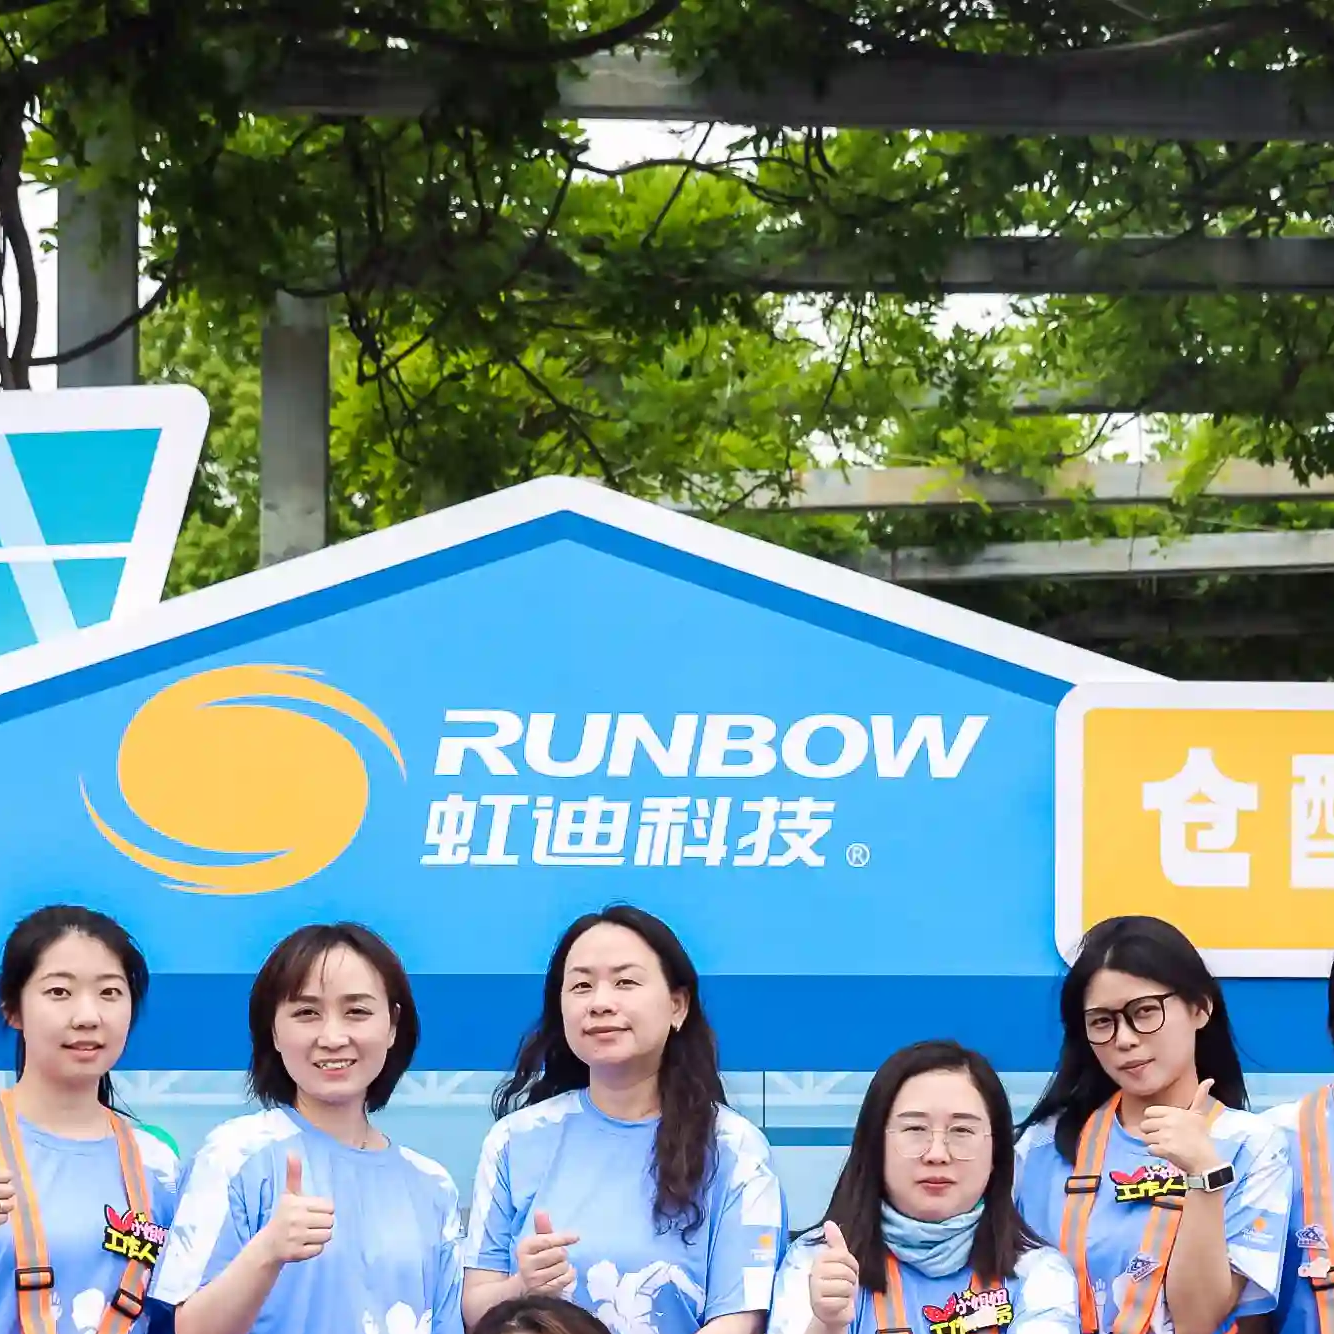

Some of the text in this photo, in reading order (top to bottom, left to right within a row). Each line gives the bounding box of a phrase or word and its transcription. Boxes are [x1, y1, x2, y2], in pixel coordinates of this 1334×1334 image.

[433, 709, 988, 779] RUNBOW
[421, 794, 836, 869] 虹迪科技
[1117, 1177, 1187, 1201] 工作人
[104, 1227, 157, 1263] 工作人
